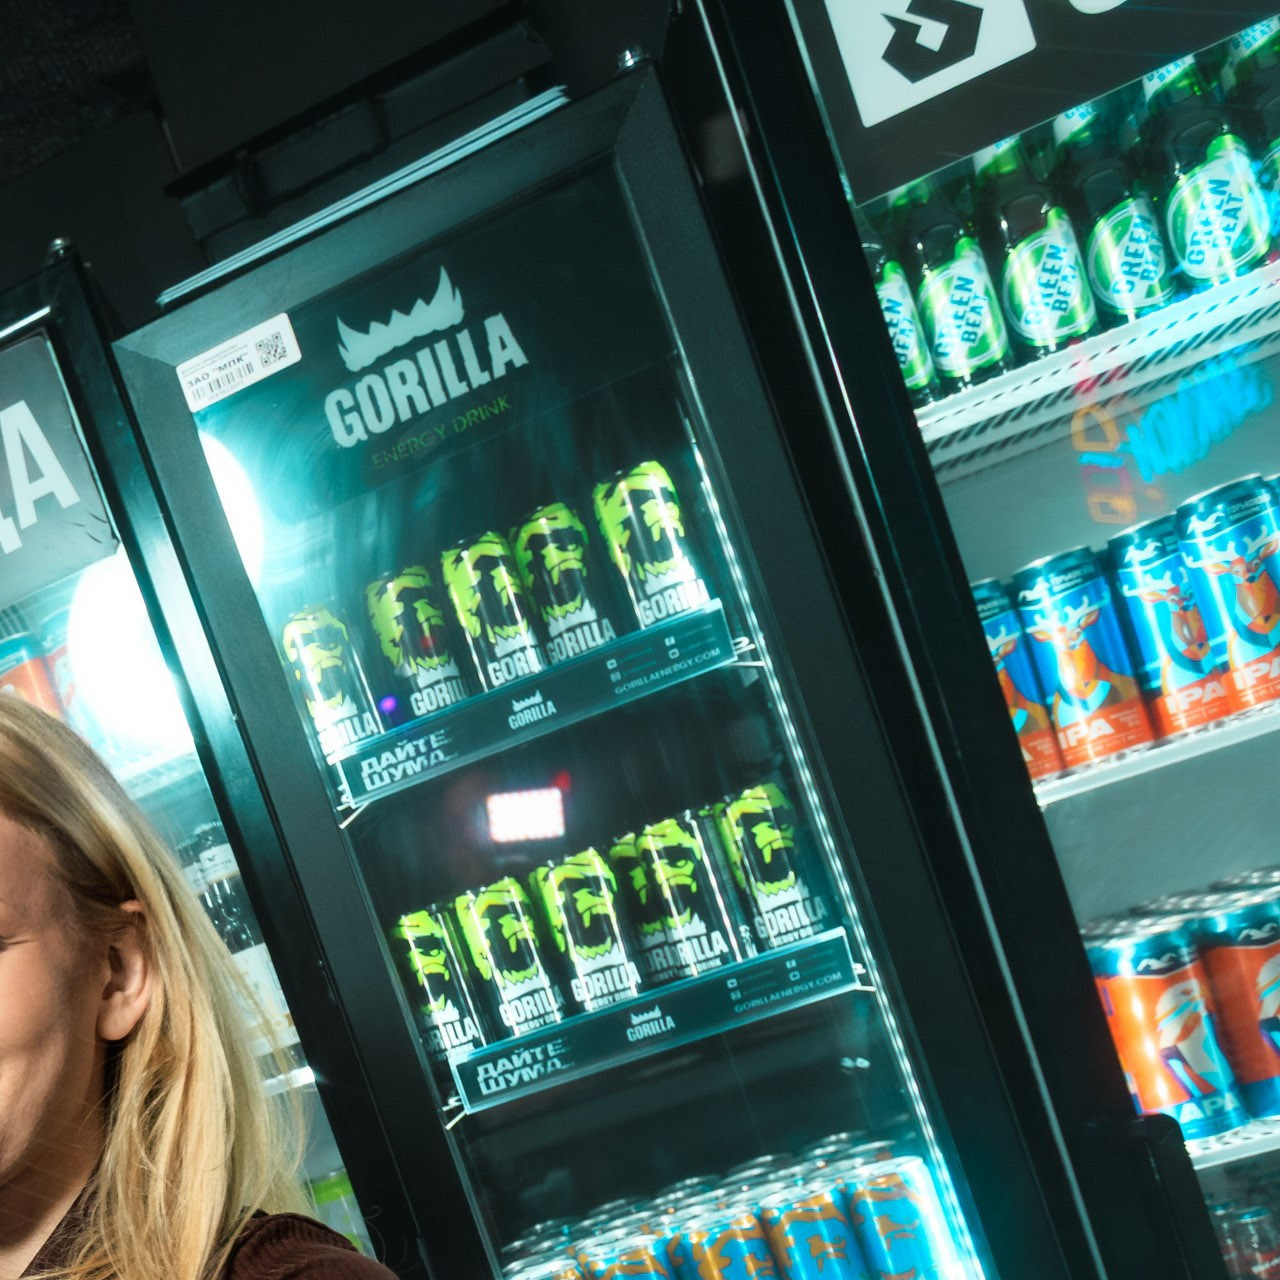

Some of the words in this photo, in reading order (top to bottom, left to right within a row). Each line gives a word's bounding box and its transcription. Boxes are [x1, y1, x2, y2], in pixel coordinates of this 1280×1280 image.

[1111, 213, 1152, 295] GREEN
[961, 293, 988, 344] BEAT
[324, 312, 529, 448] GORILLA
[372, 426, 447, 469] ENERGY
[451, 394, 512, 433] DRINK
[638, 578, 711, 626] GORILL
[547, 618, 617, 664] GORILLA
[614, 647, 721, 694] GORILLAENERGY.COM
[410, 679, 469, 716] GORILL
[508, 700, 557, 730] GORILLA
[1165, 681, 1225, 715] IPA
[360, 728, 450, 777] ДАЙТЕ
[1057, 717, 1115, 750] IPA
[754, 896, 828, 939] GORILLA
[570, 961, 642, 1002] GORILLA
[625, 1015, 676, 1043] GORILLA
[476, 1039, 566, 1082] ДАЙТЕ
